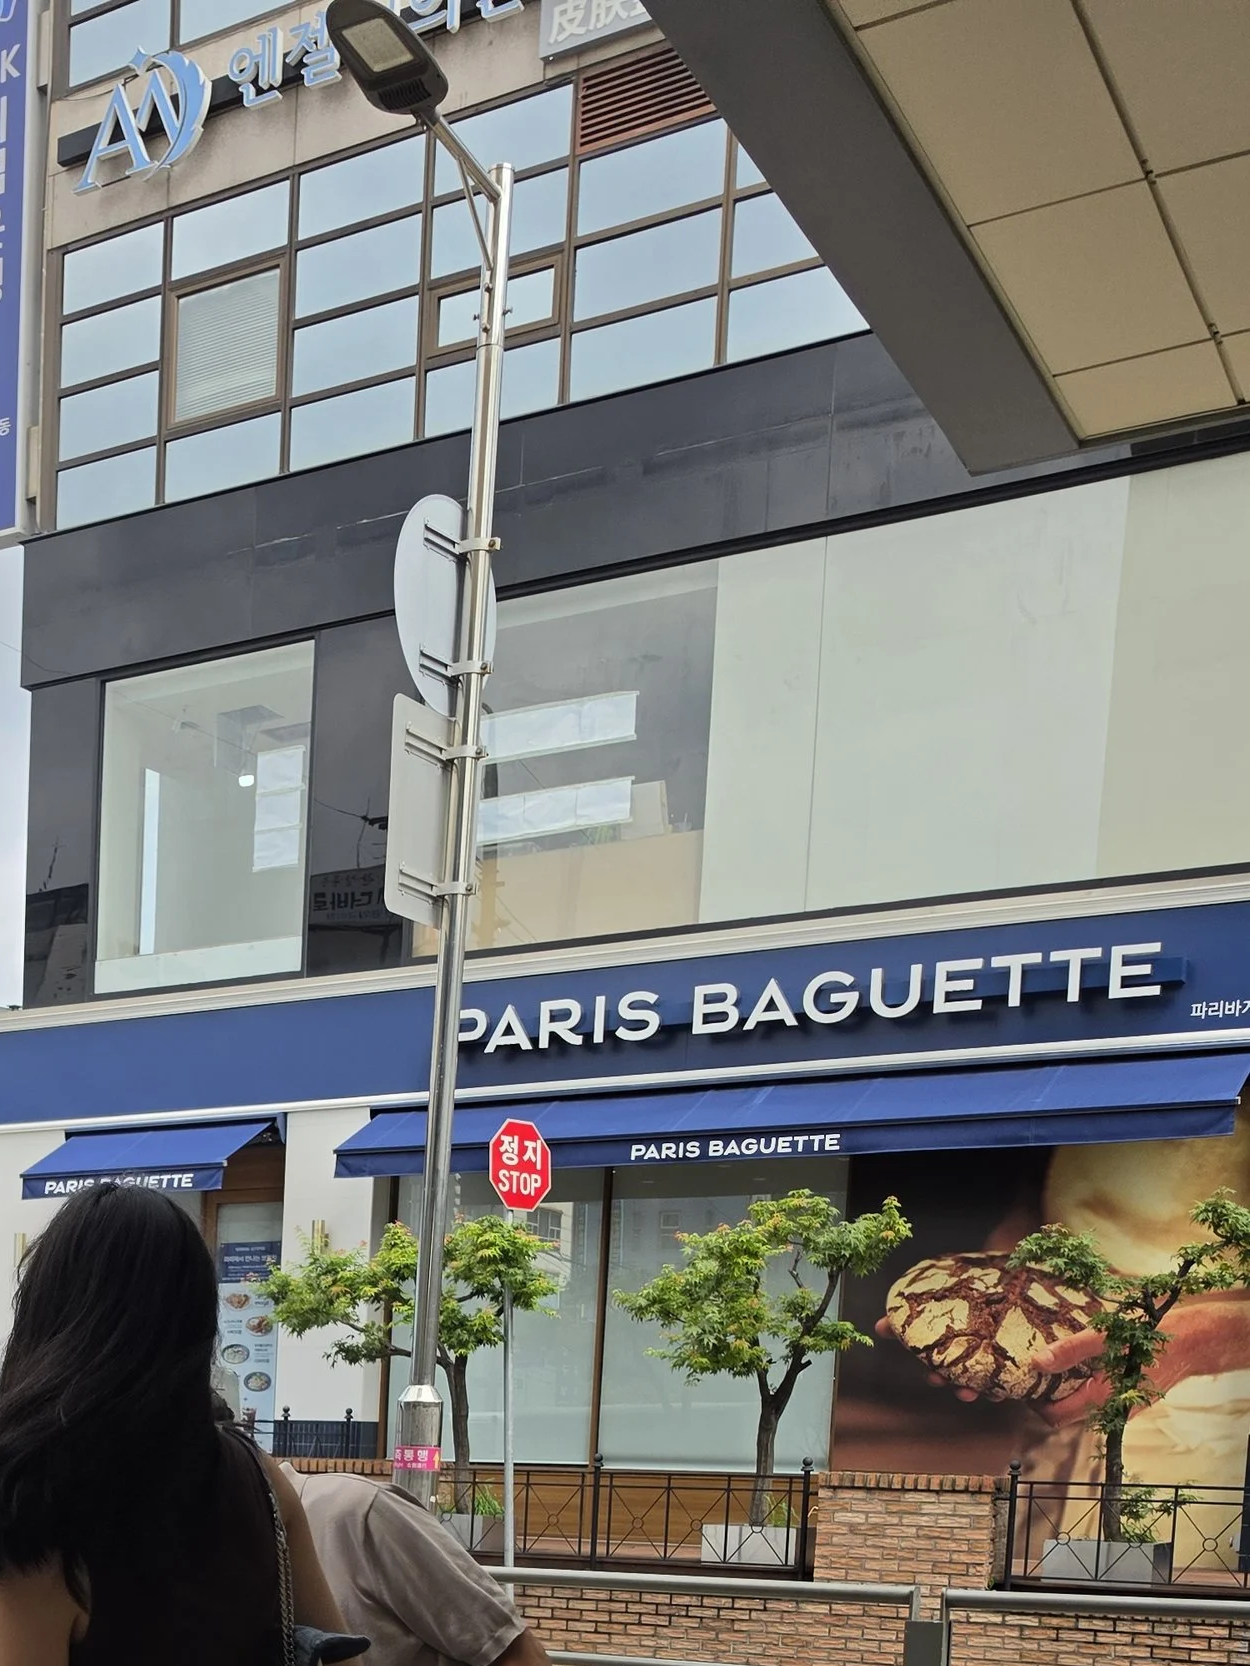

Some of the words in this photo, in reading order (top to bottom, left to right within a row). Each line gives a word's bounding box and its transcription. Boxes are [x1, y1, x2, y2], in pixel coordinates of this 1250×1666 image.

[458, 991, 662, 1054] PARIS
[691, 941, 1162, 1035] BAGUETTE
[499, 1134, 542, 1171] 정지
[630, 1141, 701, 1161] PARIS
[708, 1133, 841, 1157] BAGUETTE
[44, 1178, 95, 1195] PARIS
[498, 1169, 542, 1197] STOP
